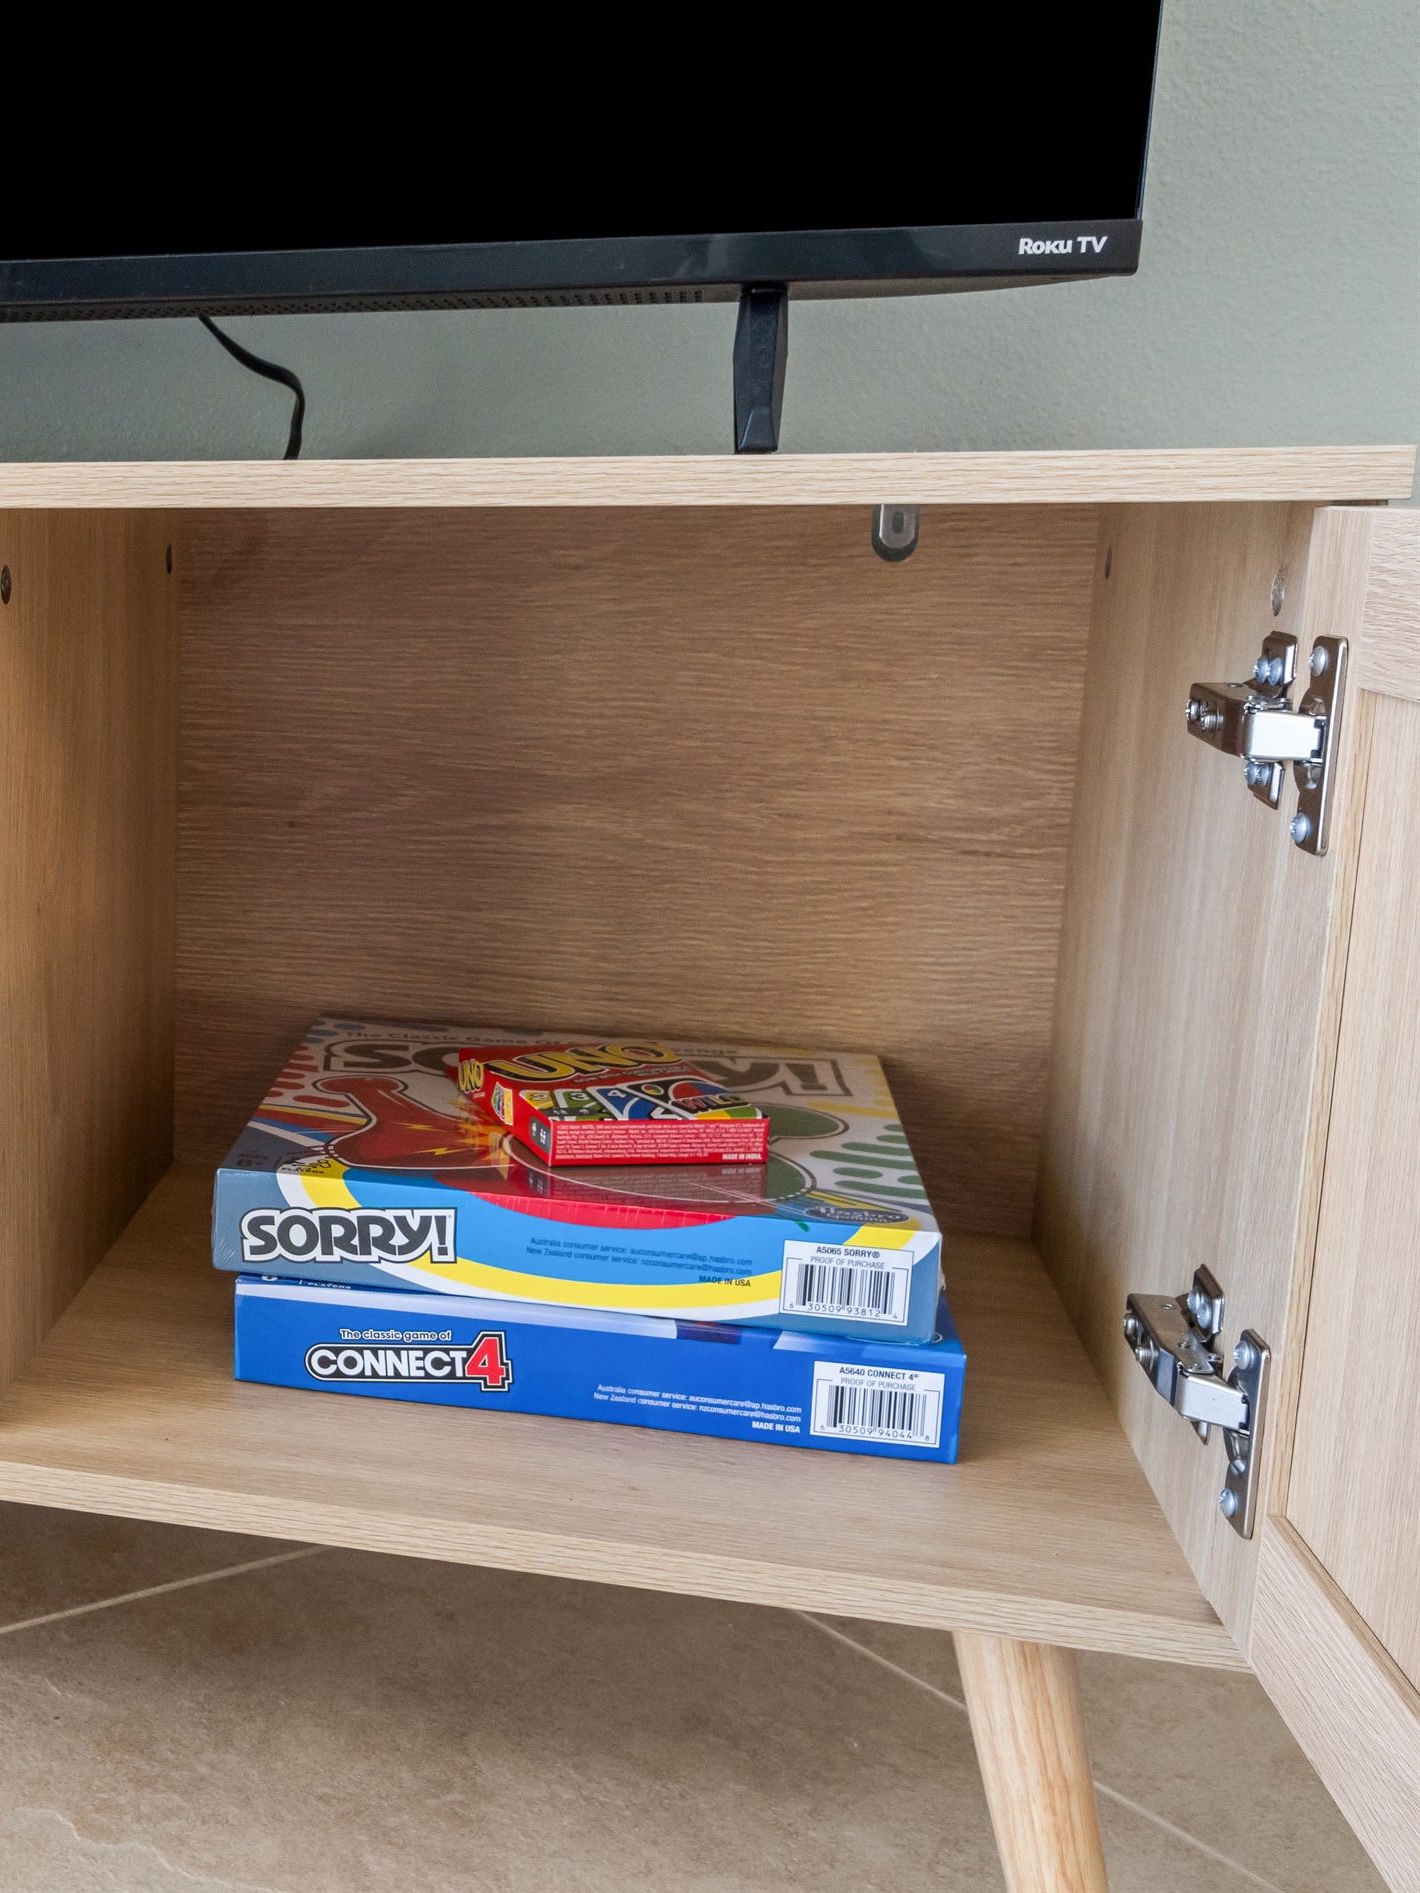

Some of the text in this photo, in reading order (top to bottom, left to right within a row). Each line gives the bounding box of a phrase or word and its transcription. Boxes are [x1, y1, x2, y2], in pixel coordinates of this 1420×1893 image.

[1077, 236, 1108, 253] TV
[483, 1042, 682, 1083] UNO
[457, 1059, 484, 1093] UNO
[571, 1091, 590, 1101] 3
[607, 1089, 627, 1099] 4
[243, 1210, 453, 1260] SORRY!
[530, 1237, 753, 1266] Australia consumer service: auconsumercare@ap.hasbro.com
[816, 1246, 842, 1256] A5065
[526, 1246, 752, 1277] New Zealand consumer service: nzconsumercare@hasbro.com
[810, 1256, 885, 1269] PROOF OF PURCHASE
[699, 1275, 751, 1287] MADE IN USA
[807, 1302, 842, 1313] 30509
[846, 1306, 881, 1318] 93812
[340, 1329, 452, 1342] The classic game of
[311, 1336, 506, 1386] CONNECT 4
[839, 1367, 865, 1376] A5640
[867, 1369, 906, 1380] CONNECT
[840, 1377, 864, 1386] PROOF
[878, 1381, 916, 1391] PURCHASE
[597, 1384, 802, 1413] Australia consumer service: auconsumercare@ap.hasbro.com
[594, 1392, 801, 1422] New Zealand consumer service: nzconsumercare@hasbro.com
[752, 1421, 800, 1433] MADE IN USA
[839, 1425, 873, 1435] 30509
[878, 1428, 912, 1439] 94044
